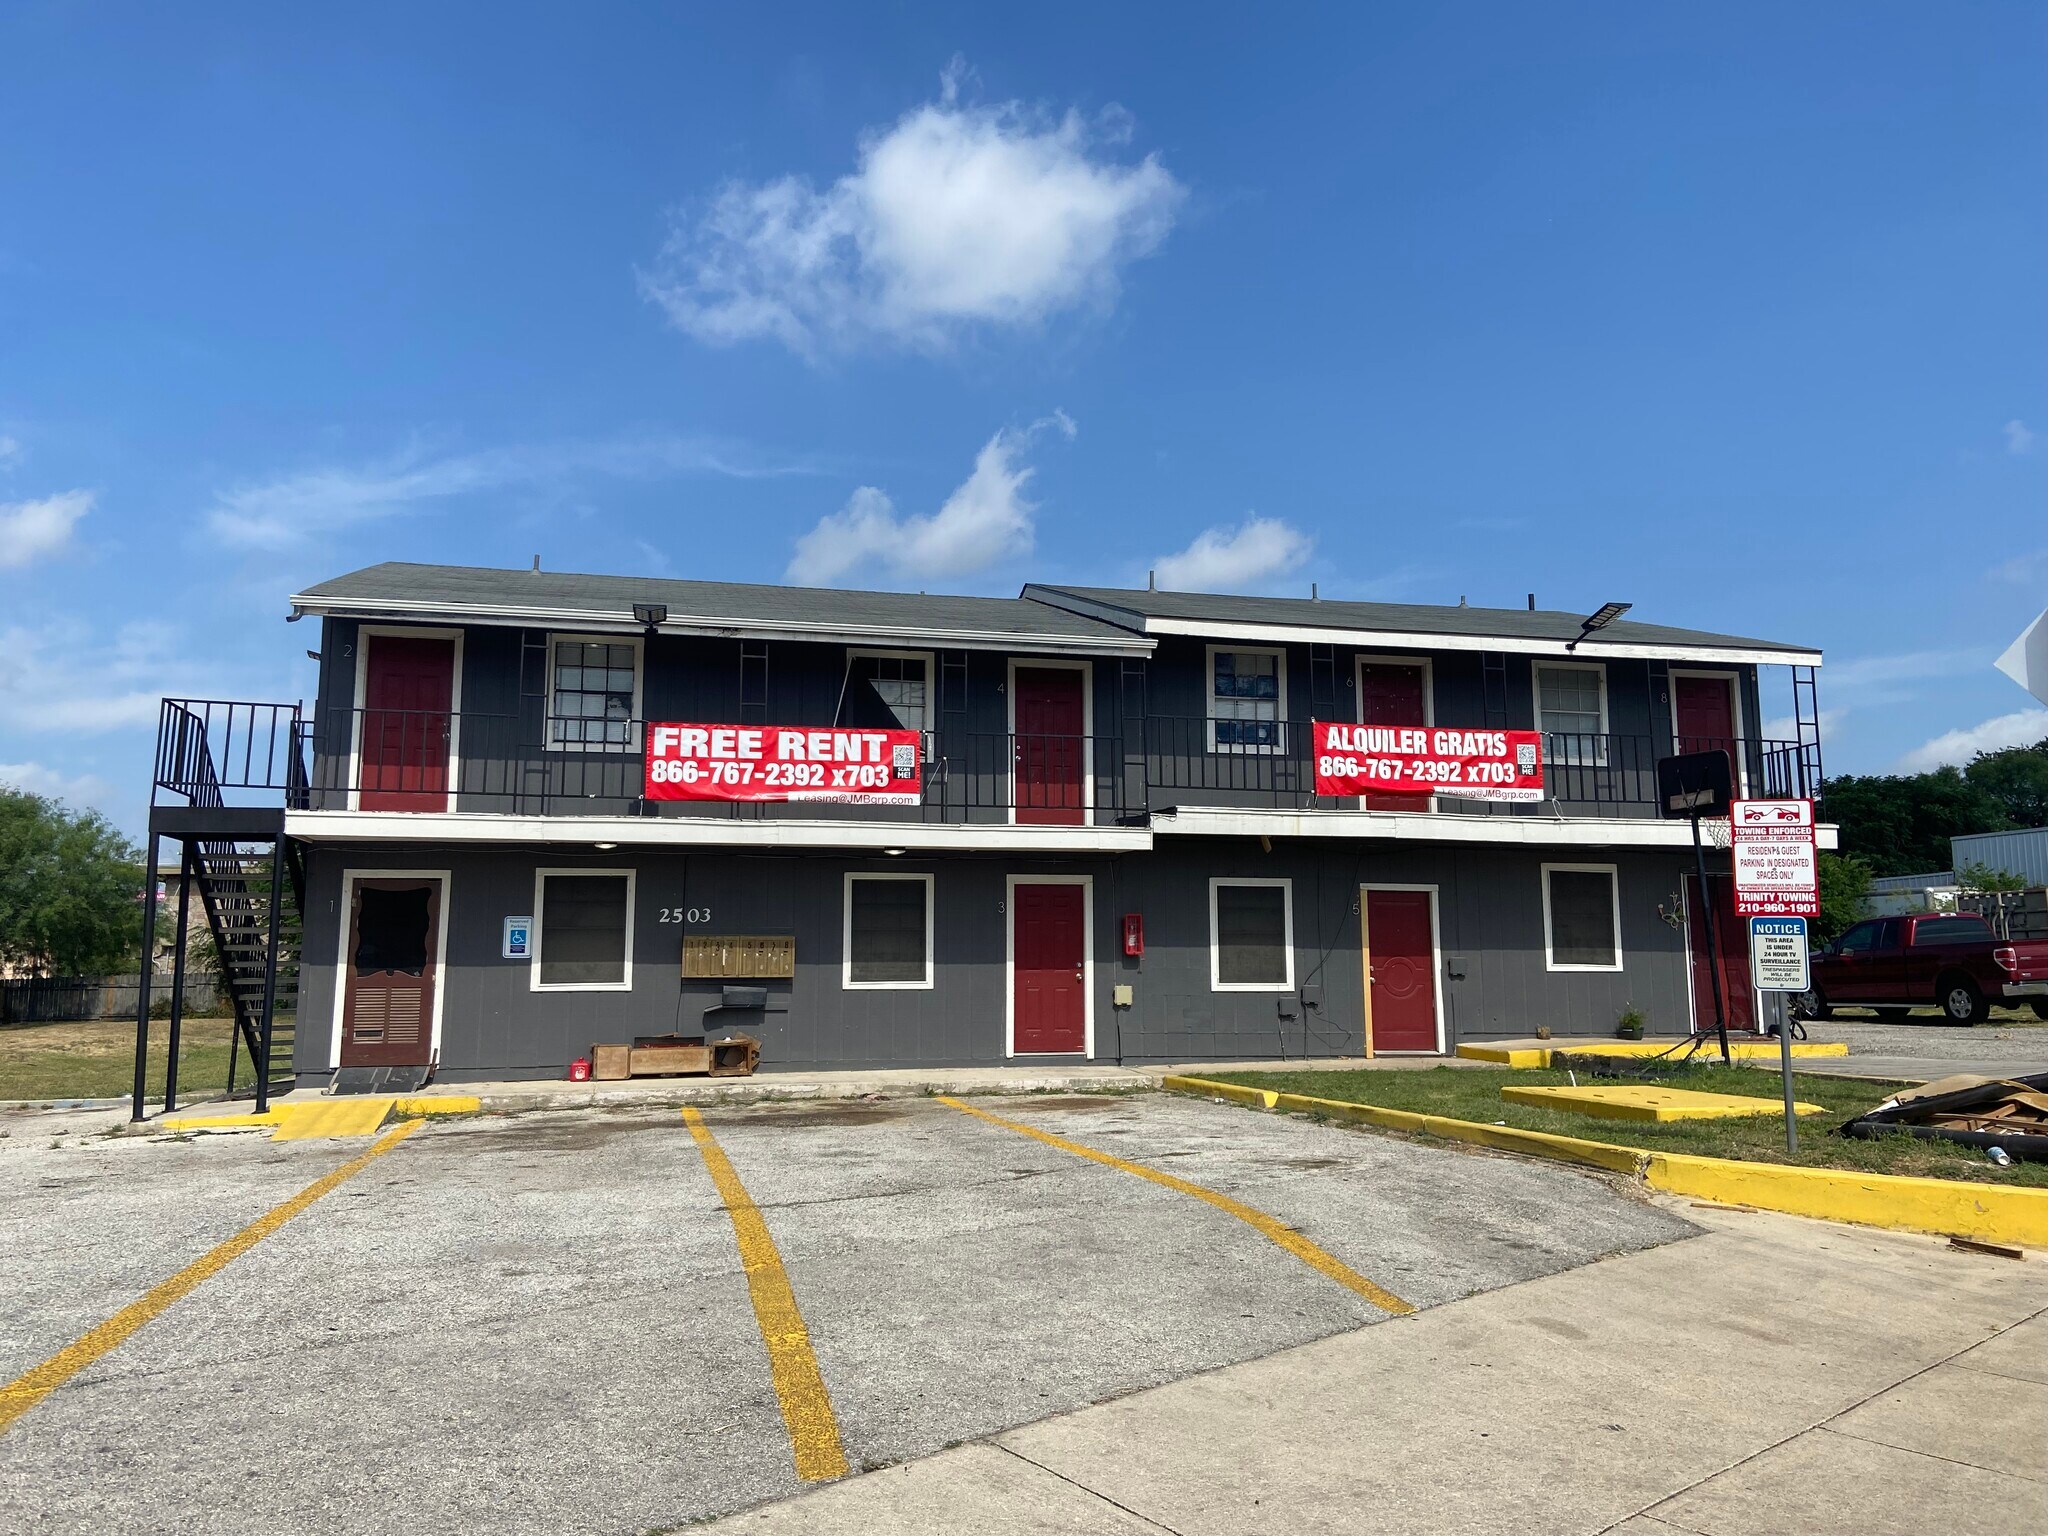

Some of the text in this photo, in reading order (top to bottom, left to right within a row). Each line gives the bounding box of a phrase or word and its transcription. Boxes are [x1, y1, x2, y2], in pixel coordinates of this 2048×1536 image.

[344, 644, 352, 657] 2
[997, 682, 1004, 694] 4
[1346, 676, 1353, 688] 6
[1660, 692, 1668, 704] 8
[653, 727, 888, 762] FREE RENT
[1326, 726, 1506, 756] ALQUILER GRATIS
[652, 760, 889, 787] 866-767-2392 x703
[1320, 756, 1515, 783] 866-767-2392 x703
[1748, 846, 1775, 855] RESIDENT
[1781, 846, 1800, 855] GUEST
[1740, 859, 1809, 867] PARKING IN DESIGNATED
[1756, 871, 1794, 879] SPACES ONLY
[1738, 892, 1816, 902] TRINITY TOWING
[998, 901, 1005, 914] 3
[1352, 903, 1360, 915] 5
[1738, 903, 1816, 913] 210-960-1901
[659, 908, 711, 924] 2503
[1756, 924, 1801, 934] NOTICE
